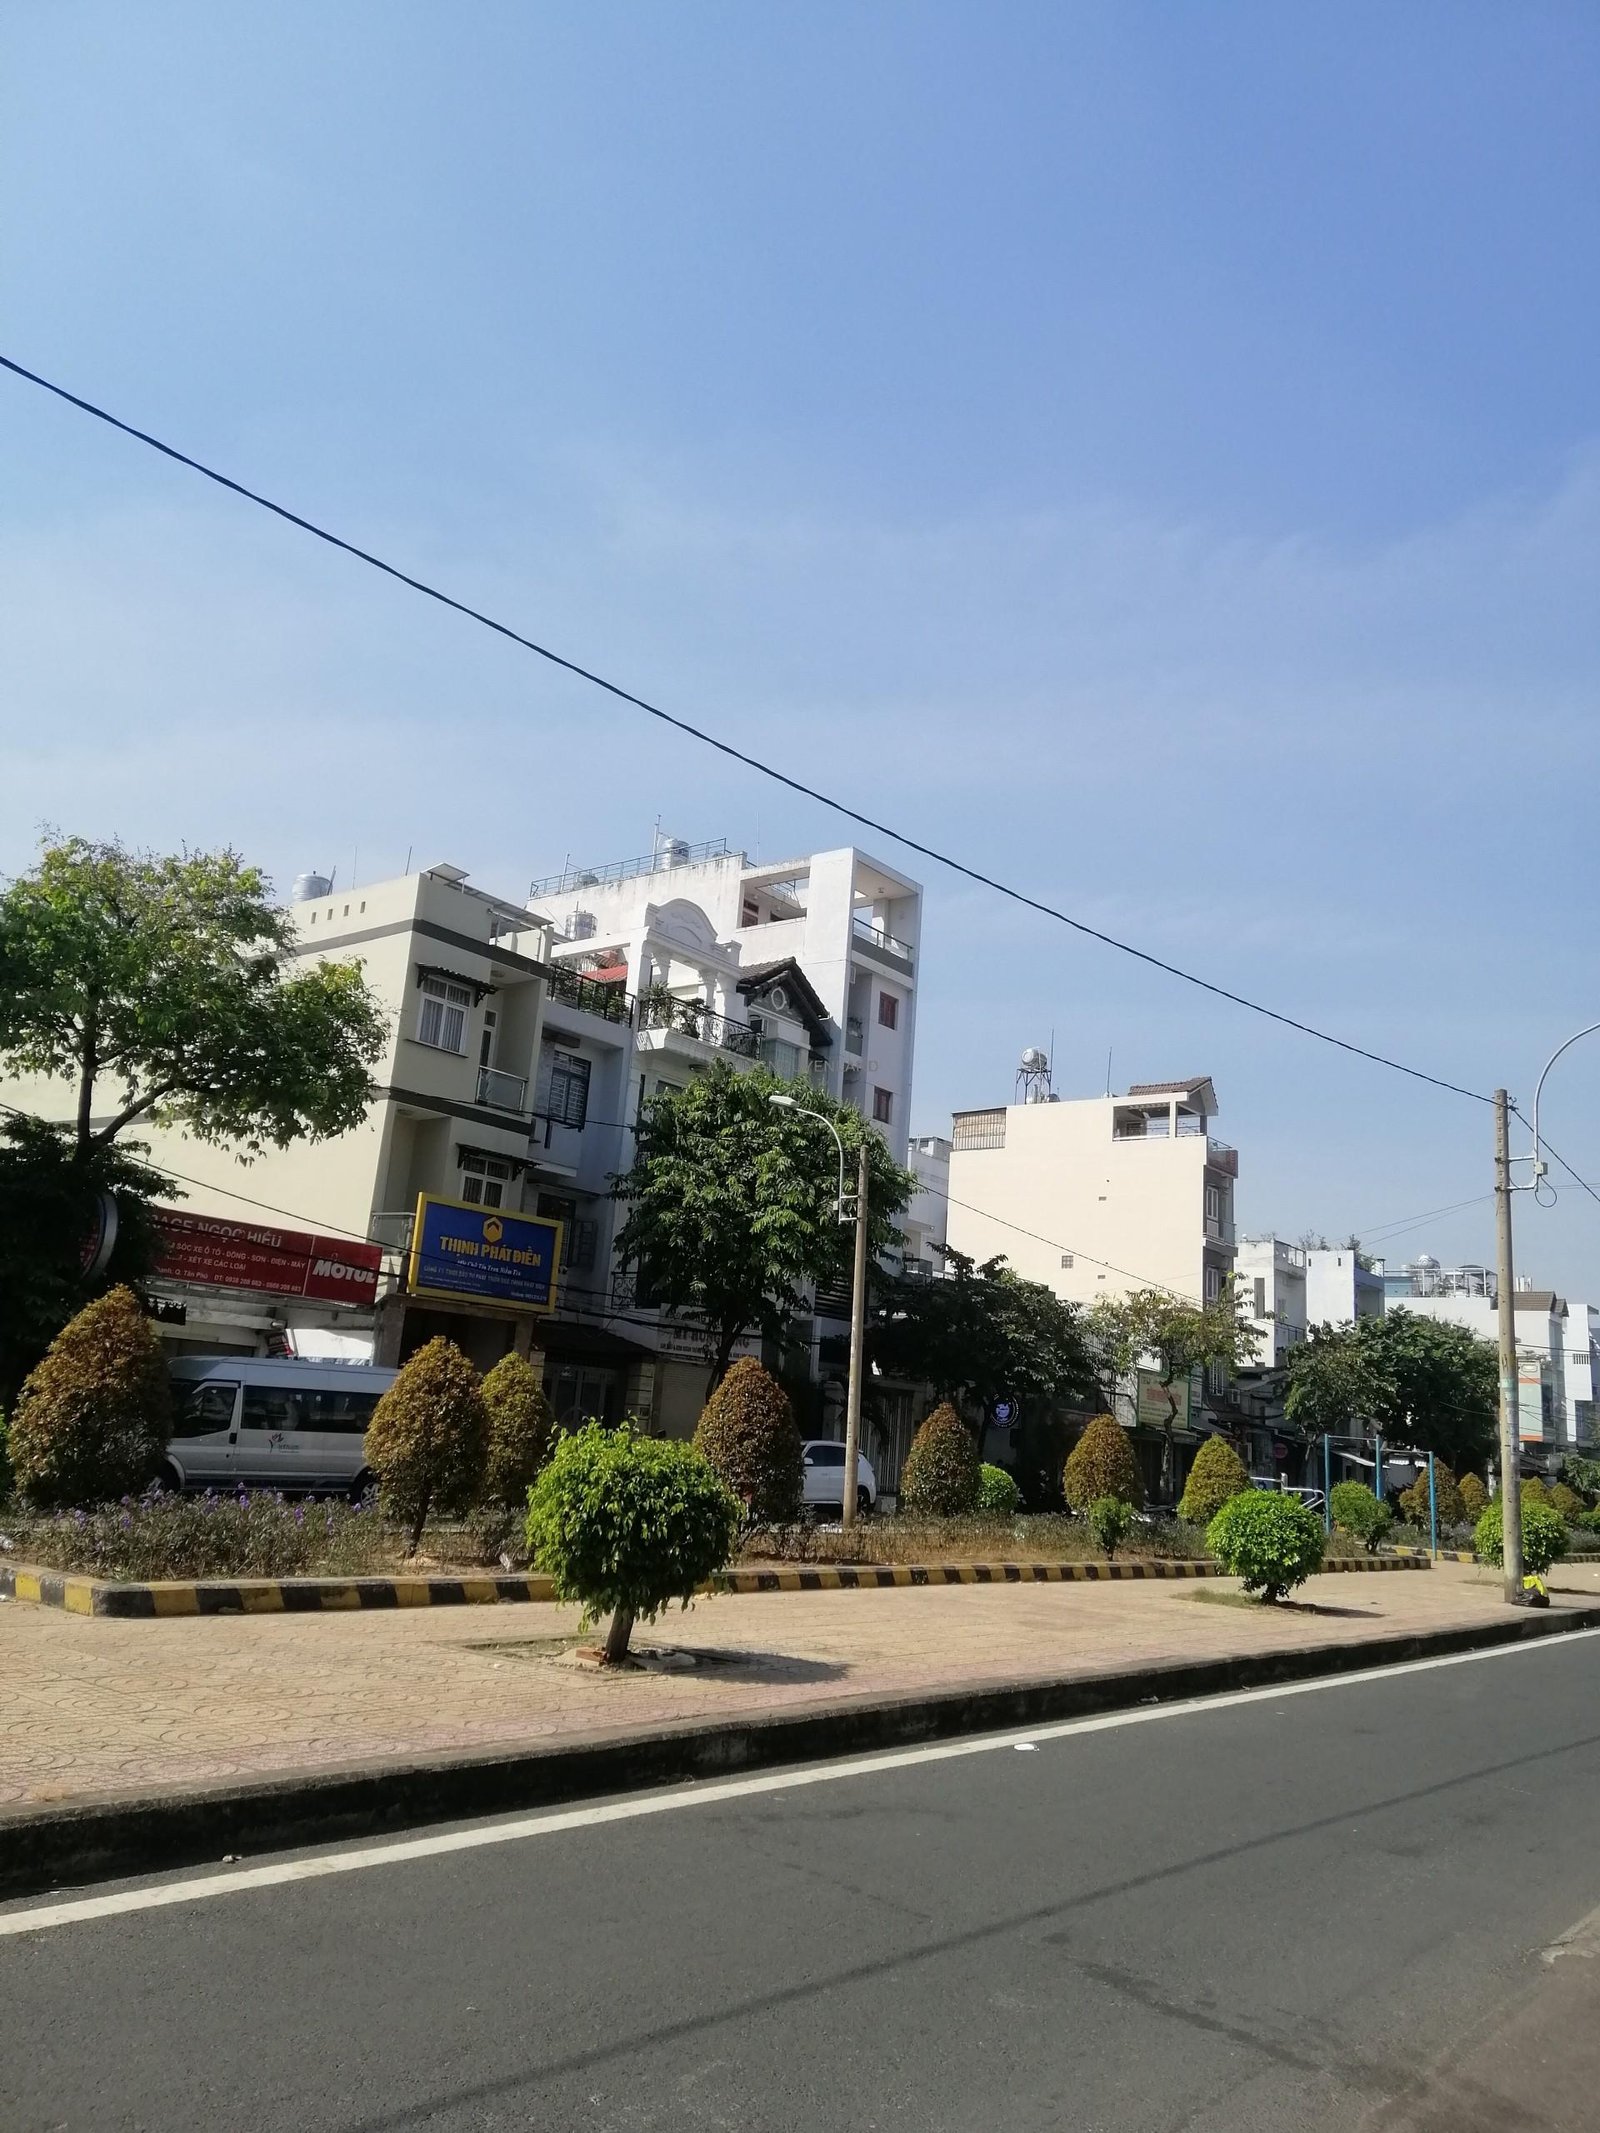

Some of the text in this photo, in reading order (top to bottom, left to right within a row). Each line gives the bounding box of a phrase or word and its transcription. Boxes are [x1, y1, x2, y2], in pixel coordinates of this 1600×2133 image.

[440, 1236, 479, 1257] THỊNH
[481, 1244, 512, 1262] PHÁT
[312, 1258, 375, 1284] MOTUL
